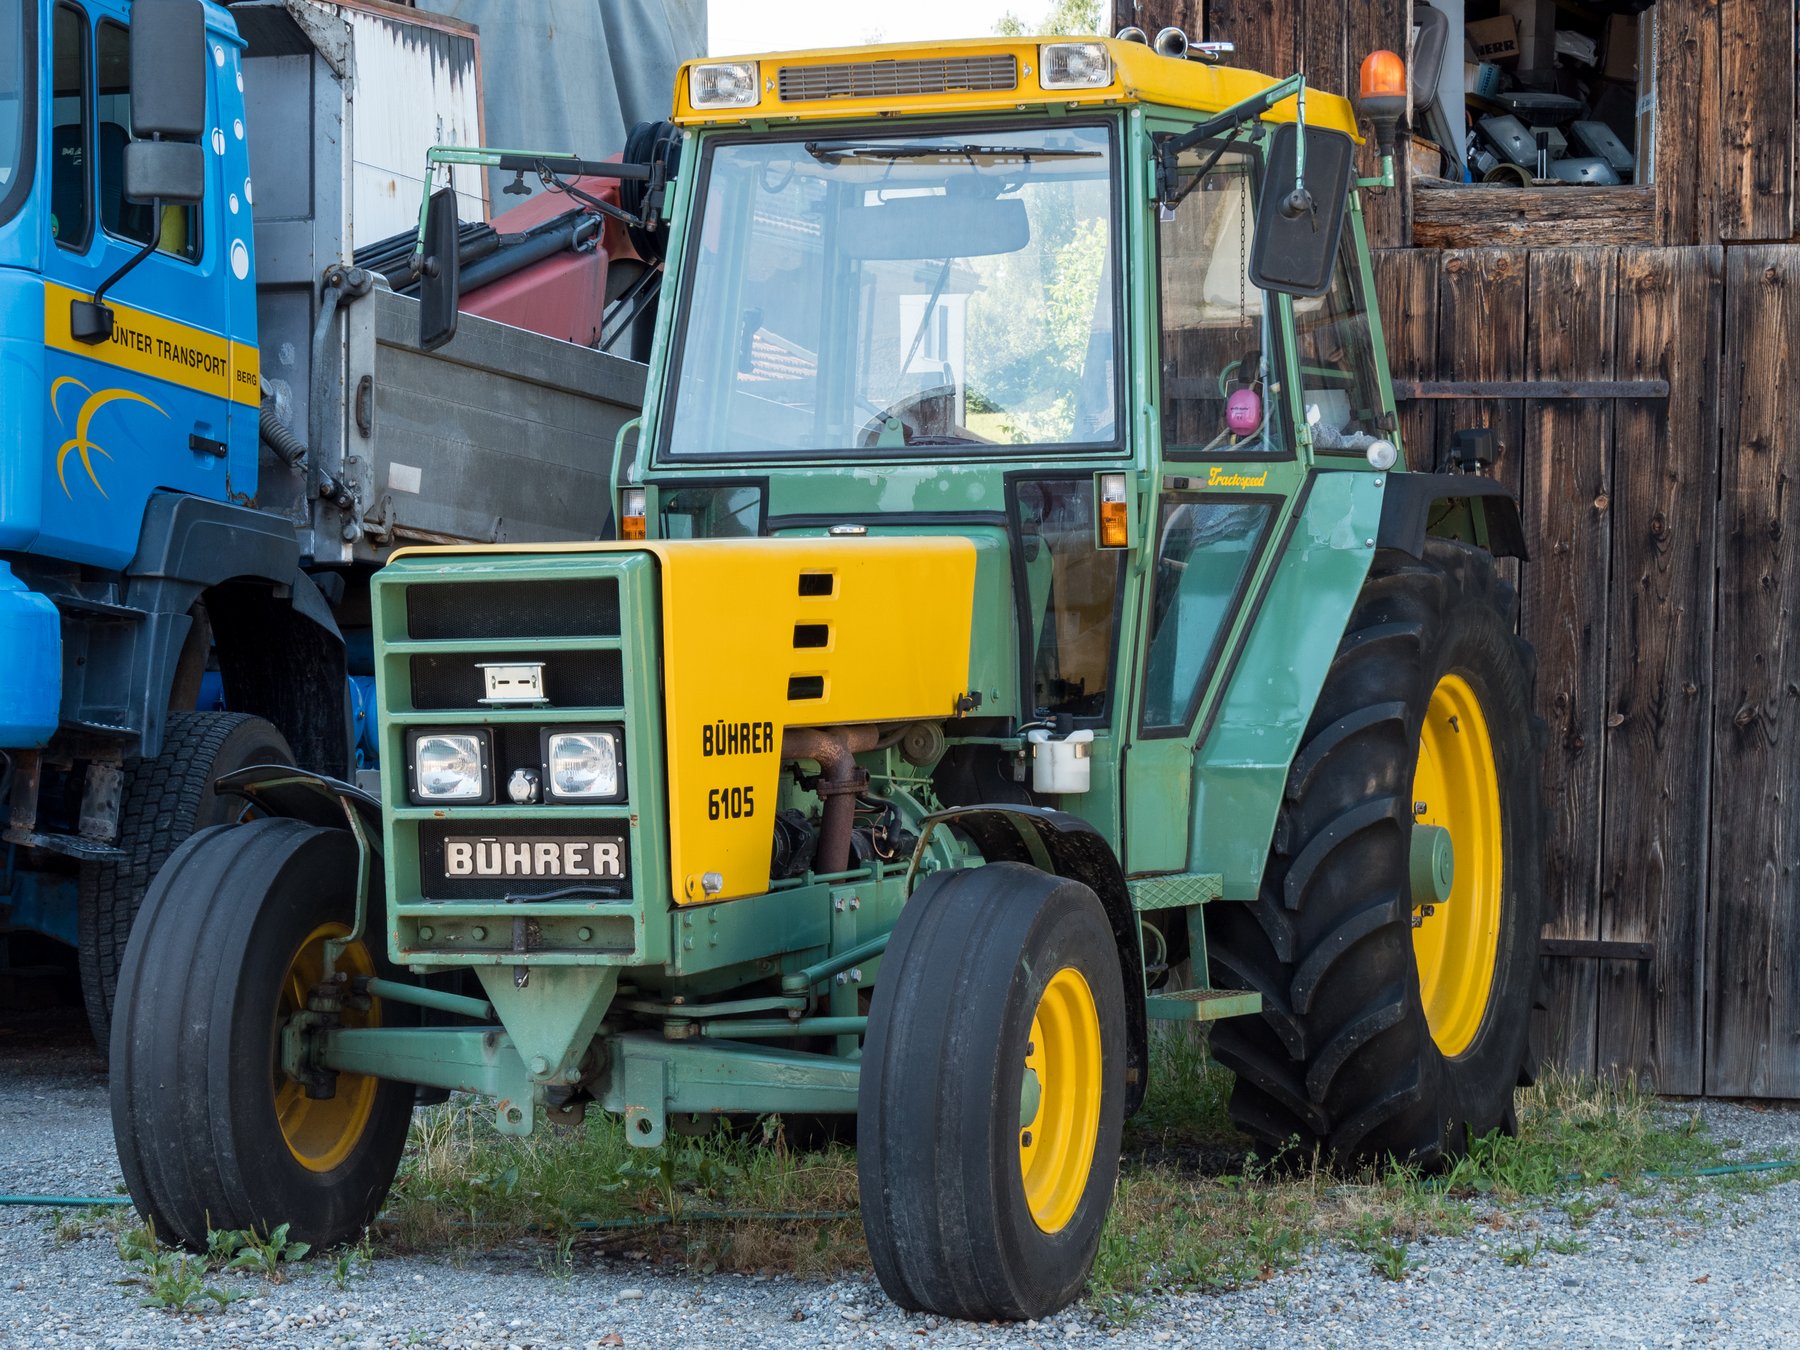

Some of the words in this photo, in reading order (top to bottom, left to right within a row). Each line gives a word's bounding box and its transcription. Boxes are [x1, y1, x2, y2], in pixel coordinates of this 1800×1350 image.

[62, 147, 82, 156] MA
[111, 320, 153, 355] ÜNTER
[156, 338, 227, 377] TRANSPORT
[236, 369, 257, 386] BERG
[1208, 466, 1268, 491] Tractospeed
[708, 785, 755, 821] 6105
